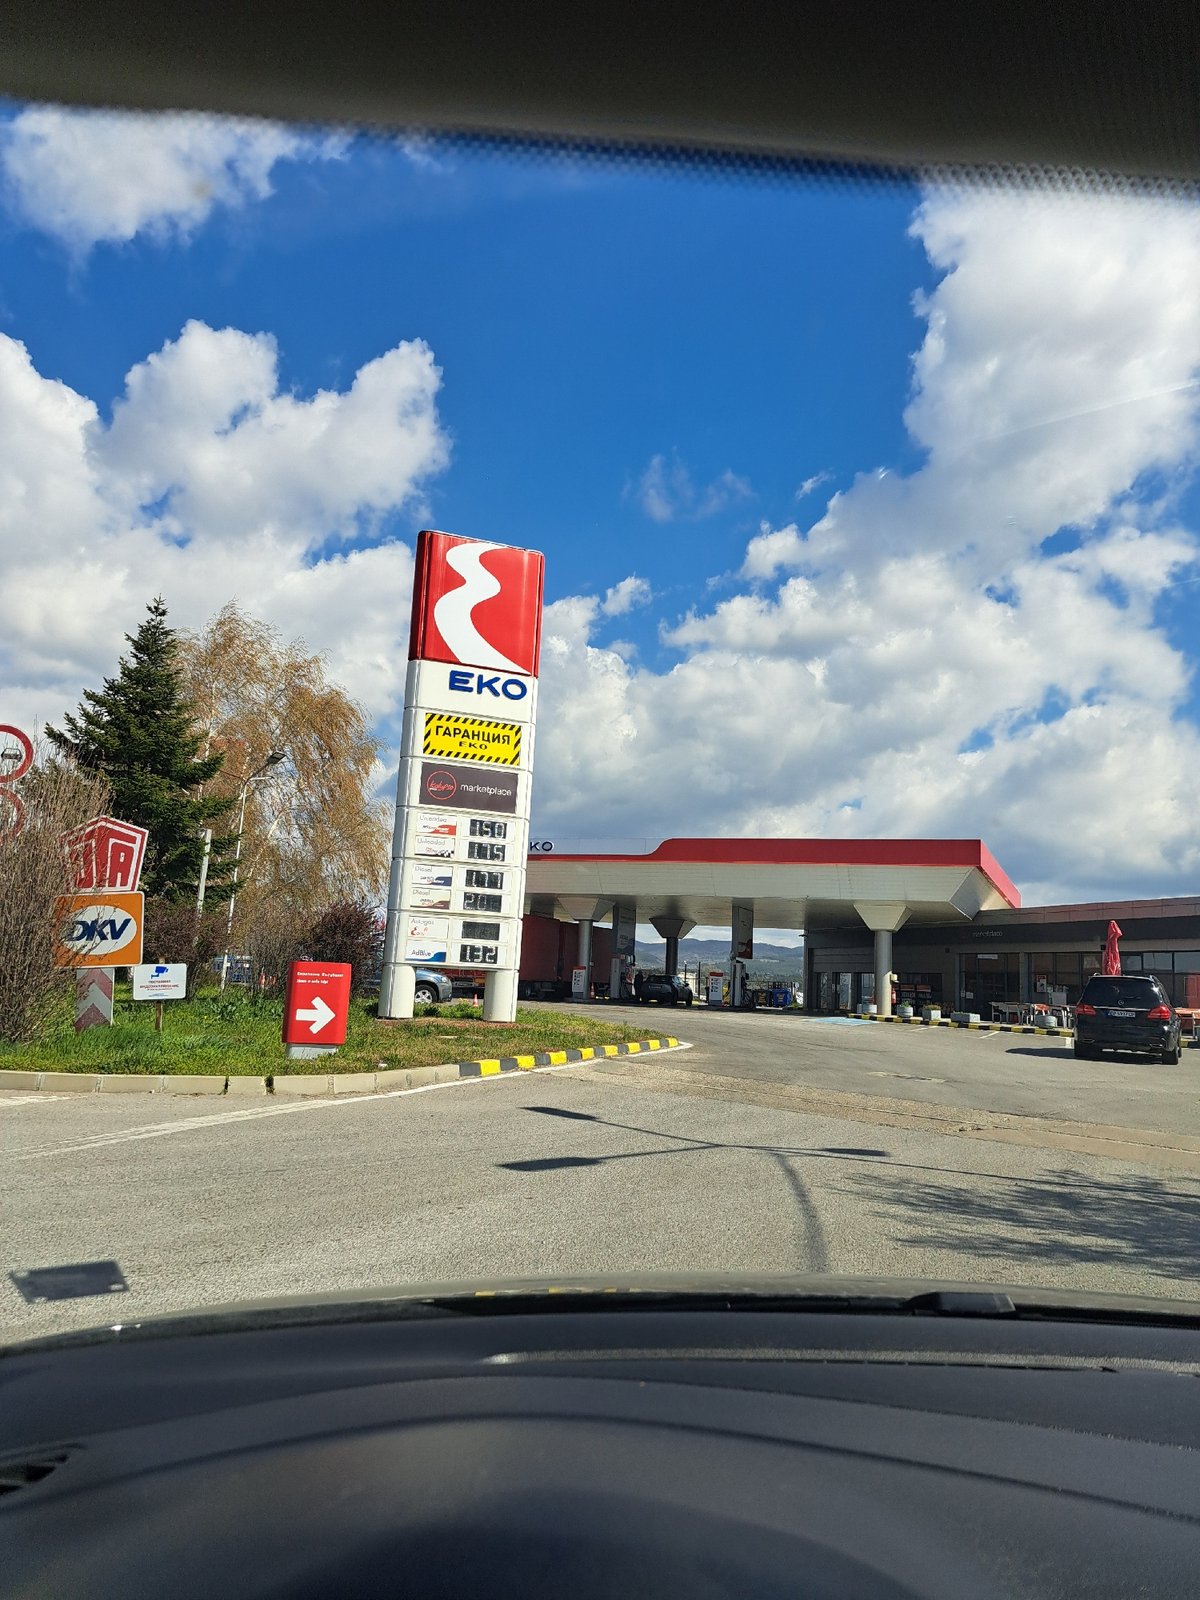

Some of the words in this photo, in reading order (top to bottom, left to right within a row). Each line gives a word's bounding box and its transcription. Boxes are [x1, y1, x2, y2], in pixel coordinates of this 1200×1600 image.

[448, 670, 527, 700] EKO
[435, 725, 510, 745] ГАРАНЦИЯ
[460, 784, 512, 797] marketplace
[530, 841, 554, 851] KO
[66, 918, 132, 942] DKV
